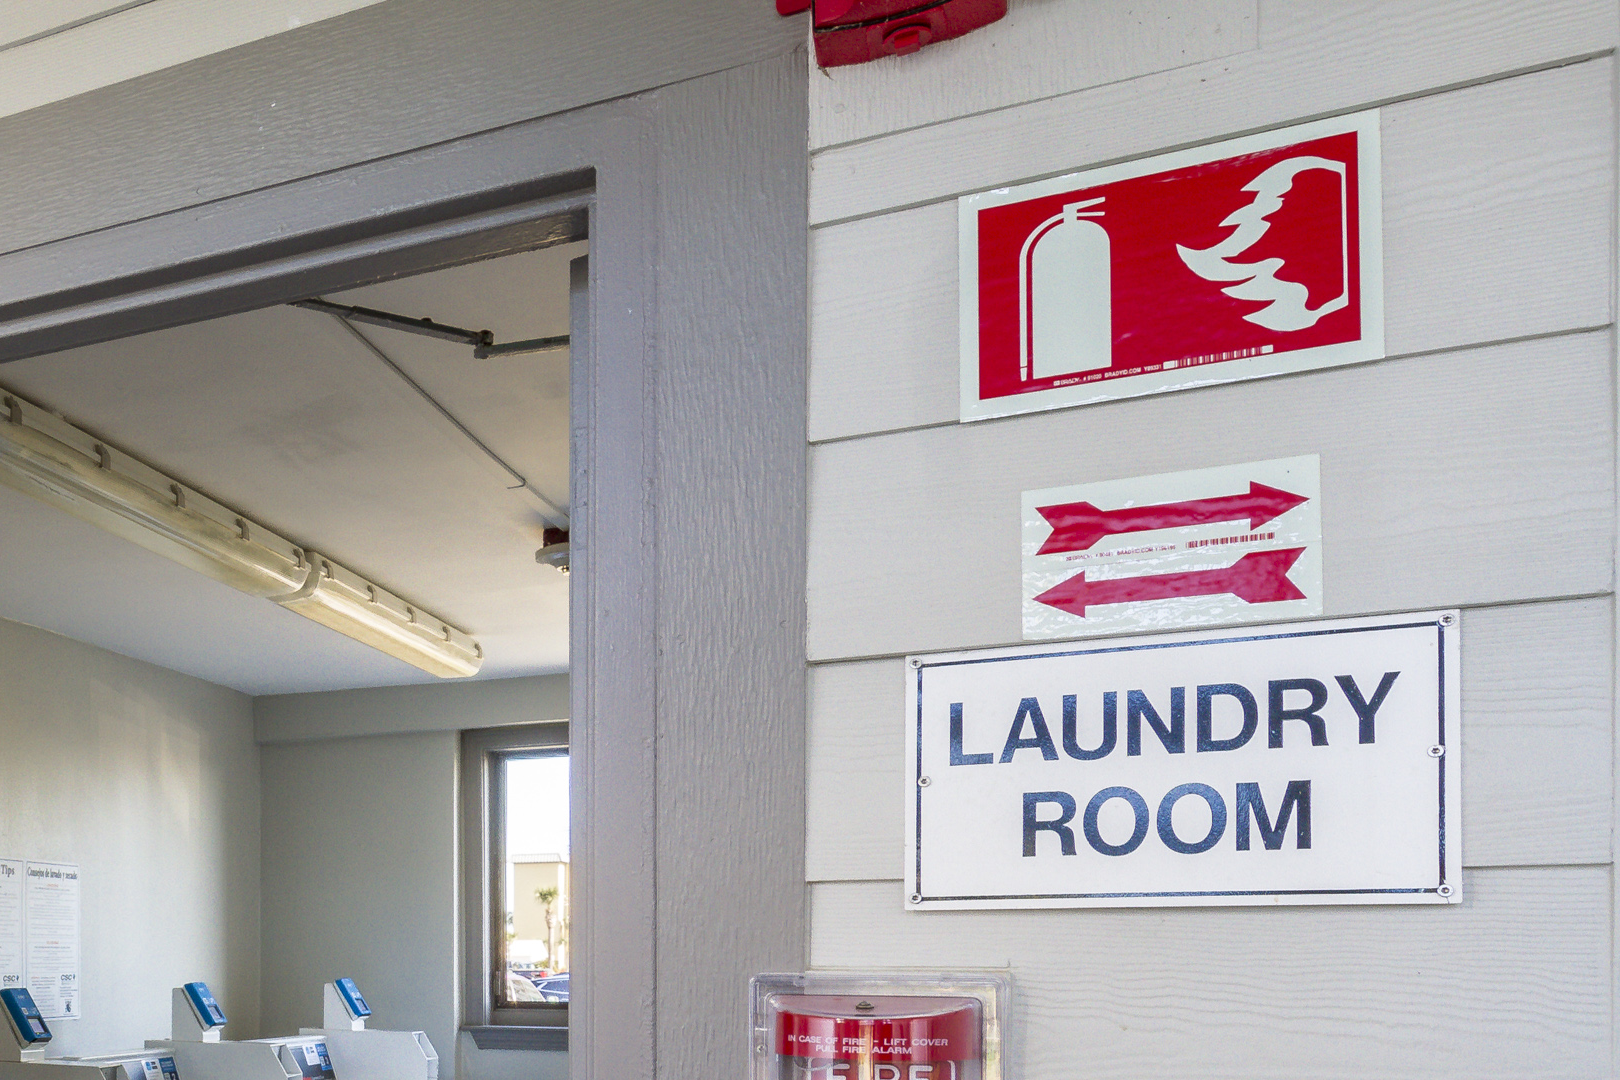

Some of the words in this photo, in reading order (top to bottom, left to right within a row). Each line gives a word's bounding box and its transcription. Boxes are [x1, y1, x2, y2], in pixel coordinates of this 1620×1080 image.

[1104, 367, 1142, 379] BRADYID.COM
[949, 671, 1401, 766] LAUNDRY
[1022, 780, 1311, 857] ROOM
[0, 864, 15, 878] Tips
[787, 1034, 796, 1042] IN
[798, 1035, 822, 1044] CASE
[842, 1037, 867, 1045] FIRE
[883, 1038, 907, 1046] LIFT
[911, 1038, 949, 1046] COVER
[815, 1044, 839, 1053] PULL
[842, 1045, 867, 1053] FIRE
[871, 1046, 912, 1054] ALARM
